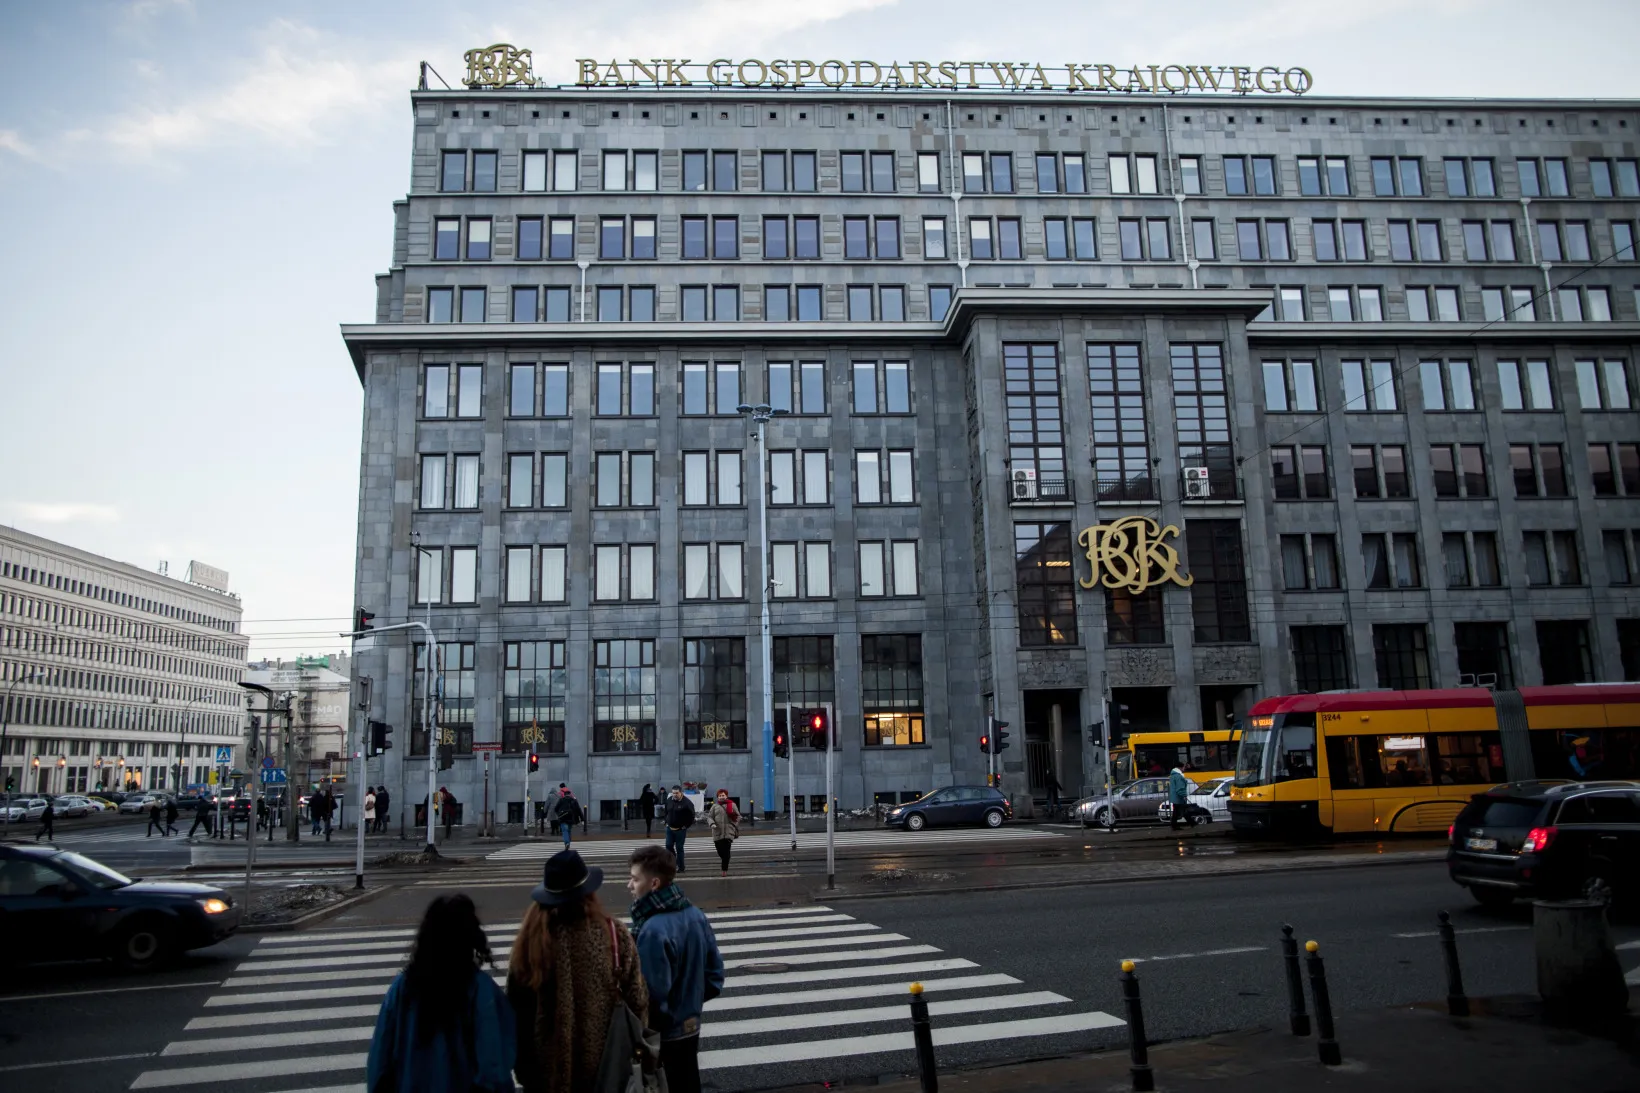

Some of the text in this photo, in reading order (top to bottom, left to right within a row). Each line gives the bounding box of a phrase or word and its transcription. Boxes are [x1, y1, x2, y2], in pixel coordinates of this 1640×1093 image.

[575, 58, 1314, 95] BANK GOSPODARSTWA KRAJOWEGO
[1322, 713, 1341, 721] 3244
